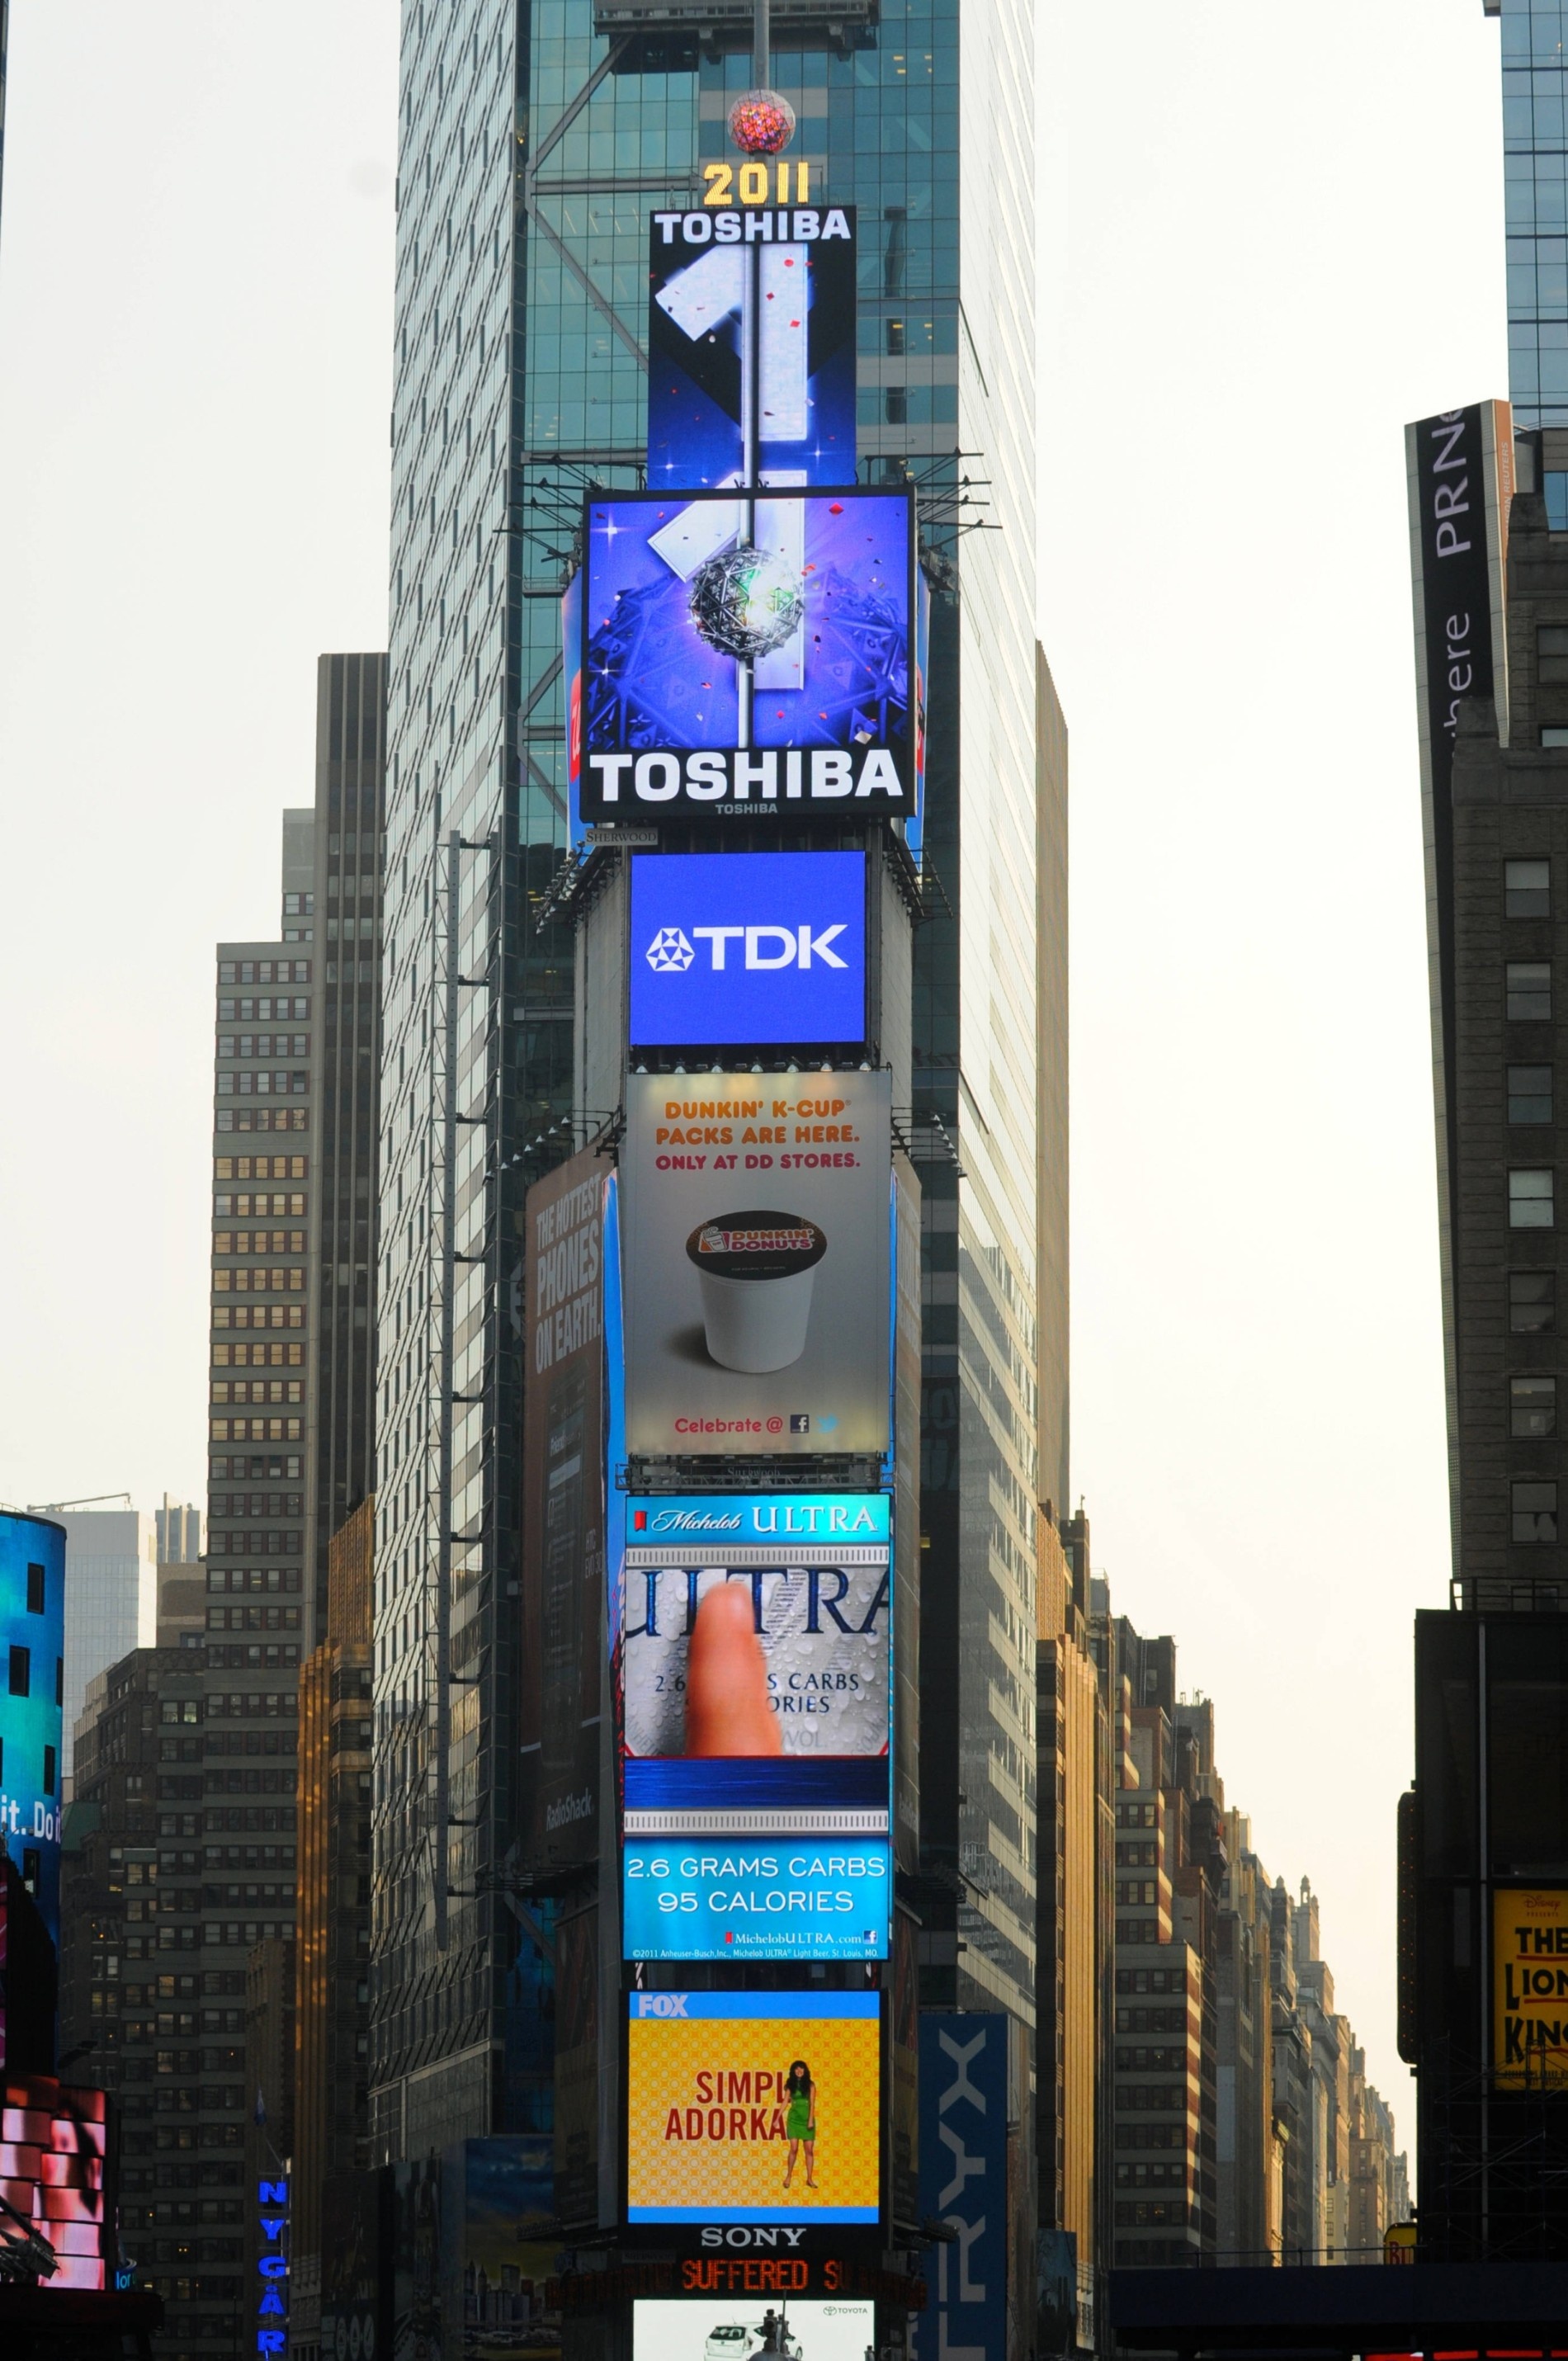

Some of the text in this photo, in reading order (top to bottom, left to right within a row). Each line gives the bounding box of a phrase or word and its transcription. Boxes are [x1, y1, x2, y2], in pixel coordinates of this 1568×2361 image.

[704, 163, 809, 205] 2011
[654, 210, 851, 244] TOSHIBA
[1502, 442, 1511, 493] REUTERS
[590, 749, 903, 801] TOSHIBA
[716, 804, 778, 815] TOSHIBA
[587, 831, 657, 843] SHERWOOD
[693, 924, 848, 970] TDK
[665, 1100, 764, 1120] DUNKIN'
[656, 1125, 860, 1145] PACKS ARE HERE.
[655, 1153, 861, 1170] ONLY AT DD STORES.
[536, 1172, 602, 1251] THE HOTTEST
[732, 1230, 812, 1240] DUNKIN'
[536, 1218, 599, 1318] PHONES
[536, 1287, 602, 1375] ON EARTH.
[675, 1417, 762, 1433] Celebrate
[767, 1417, 783, 1434] @
[651, 1505, 878, 1532] Michelob ULTRA
[585, 1528, 596, 1553] HTC
[584, 1556, 594, 1580] EVO
[789, 1673, 860, 1691] CARBS
[34, 1801, 54, 1841] Do
[546, 1787, 593, 1832] RadioShack
[628, 1857, 886, 1877] 2.6 GRAMS CARBS
[658, 1891, 854, 1913] 95 CALORIES
[1515, 1927, 1568, 1954] THE
[632, 1949, 658, 1958] ©2011
[733, 1948, 763, 1958] Michelob
[793, 1948, 811, 1959] Light
[865, 1948, 878, 1957] MO.
[638, 1995, 689, 2018] FOX
[701, 2227, 807, 2247] SONY
[681, 2258, 810, 2291] SUFFERED
